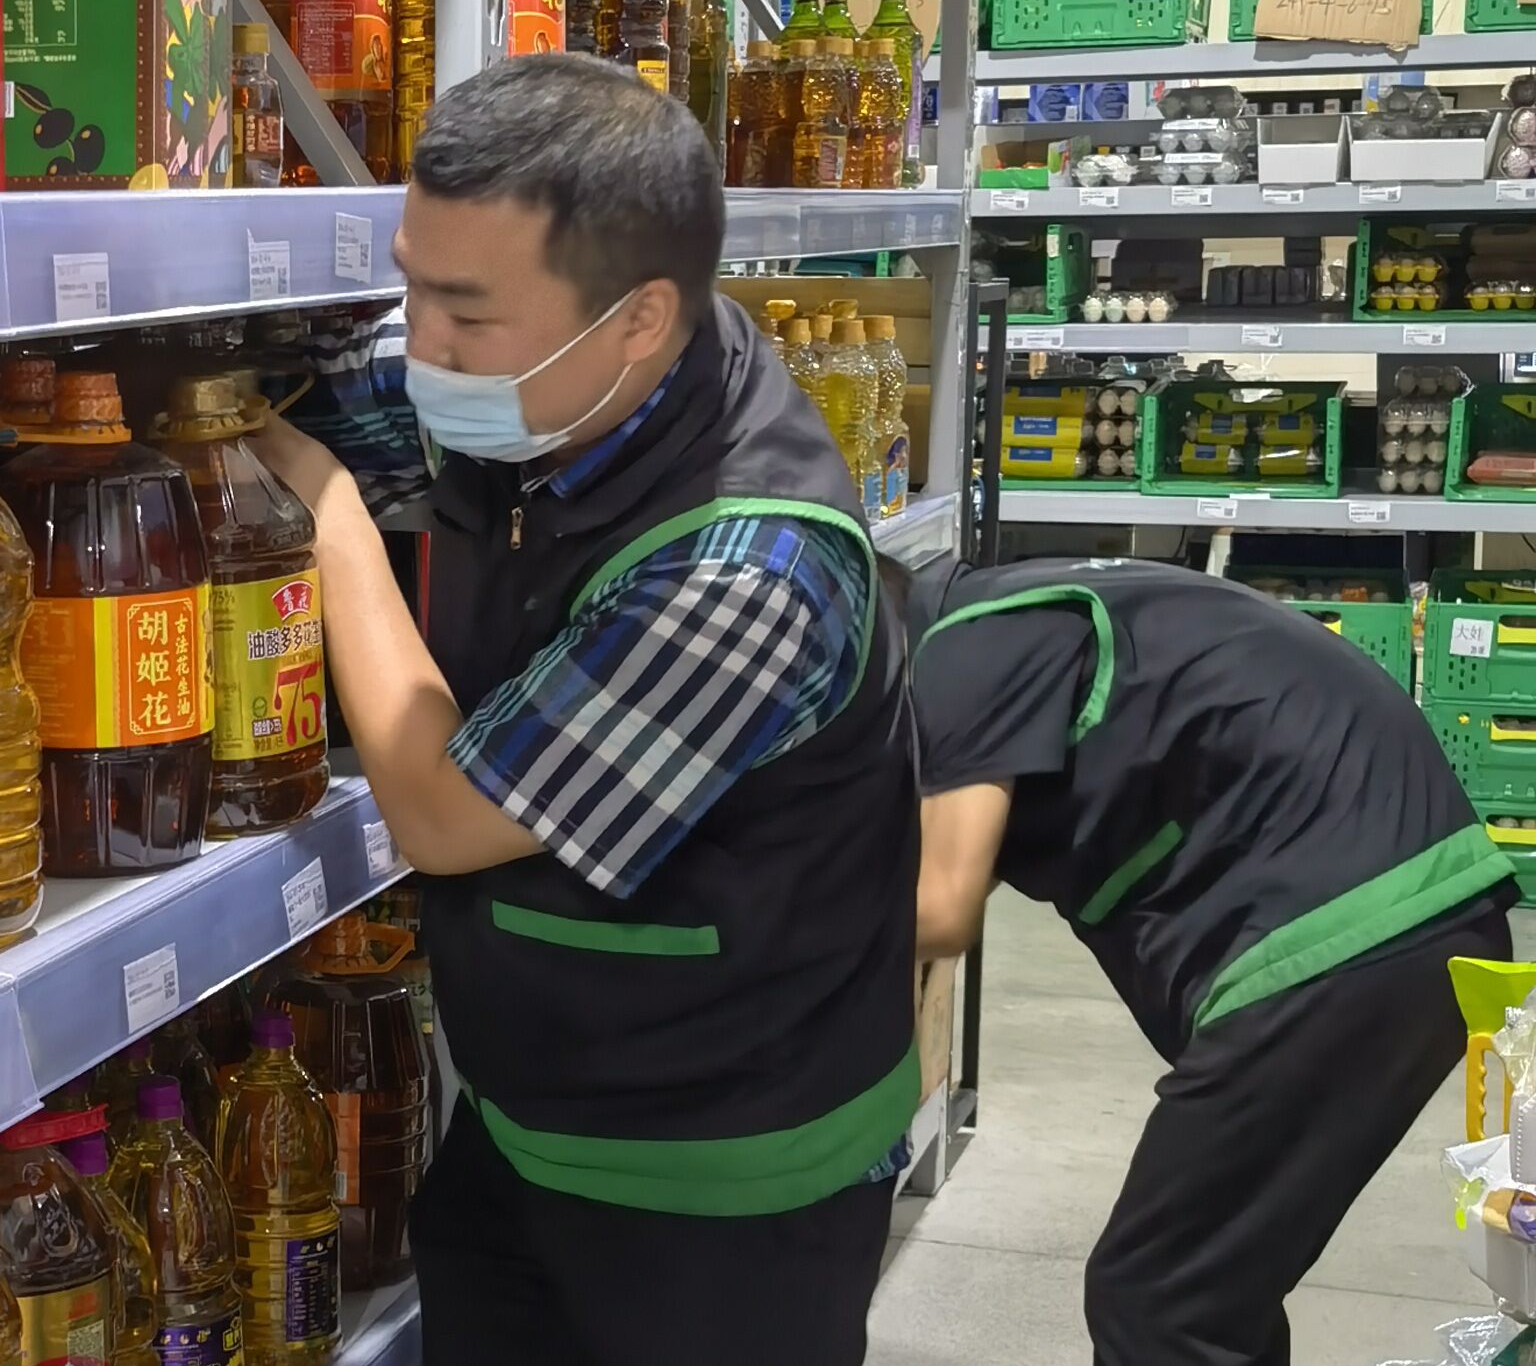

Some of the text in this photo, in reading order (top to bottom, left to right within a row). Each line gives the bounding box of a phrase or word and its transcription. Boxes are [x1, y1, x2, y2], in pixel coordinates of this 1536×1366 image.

[135, 610, 172, 728] 胡姬花
[174, 613, 191, 716] 古法花生油
